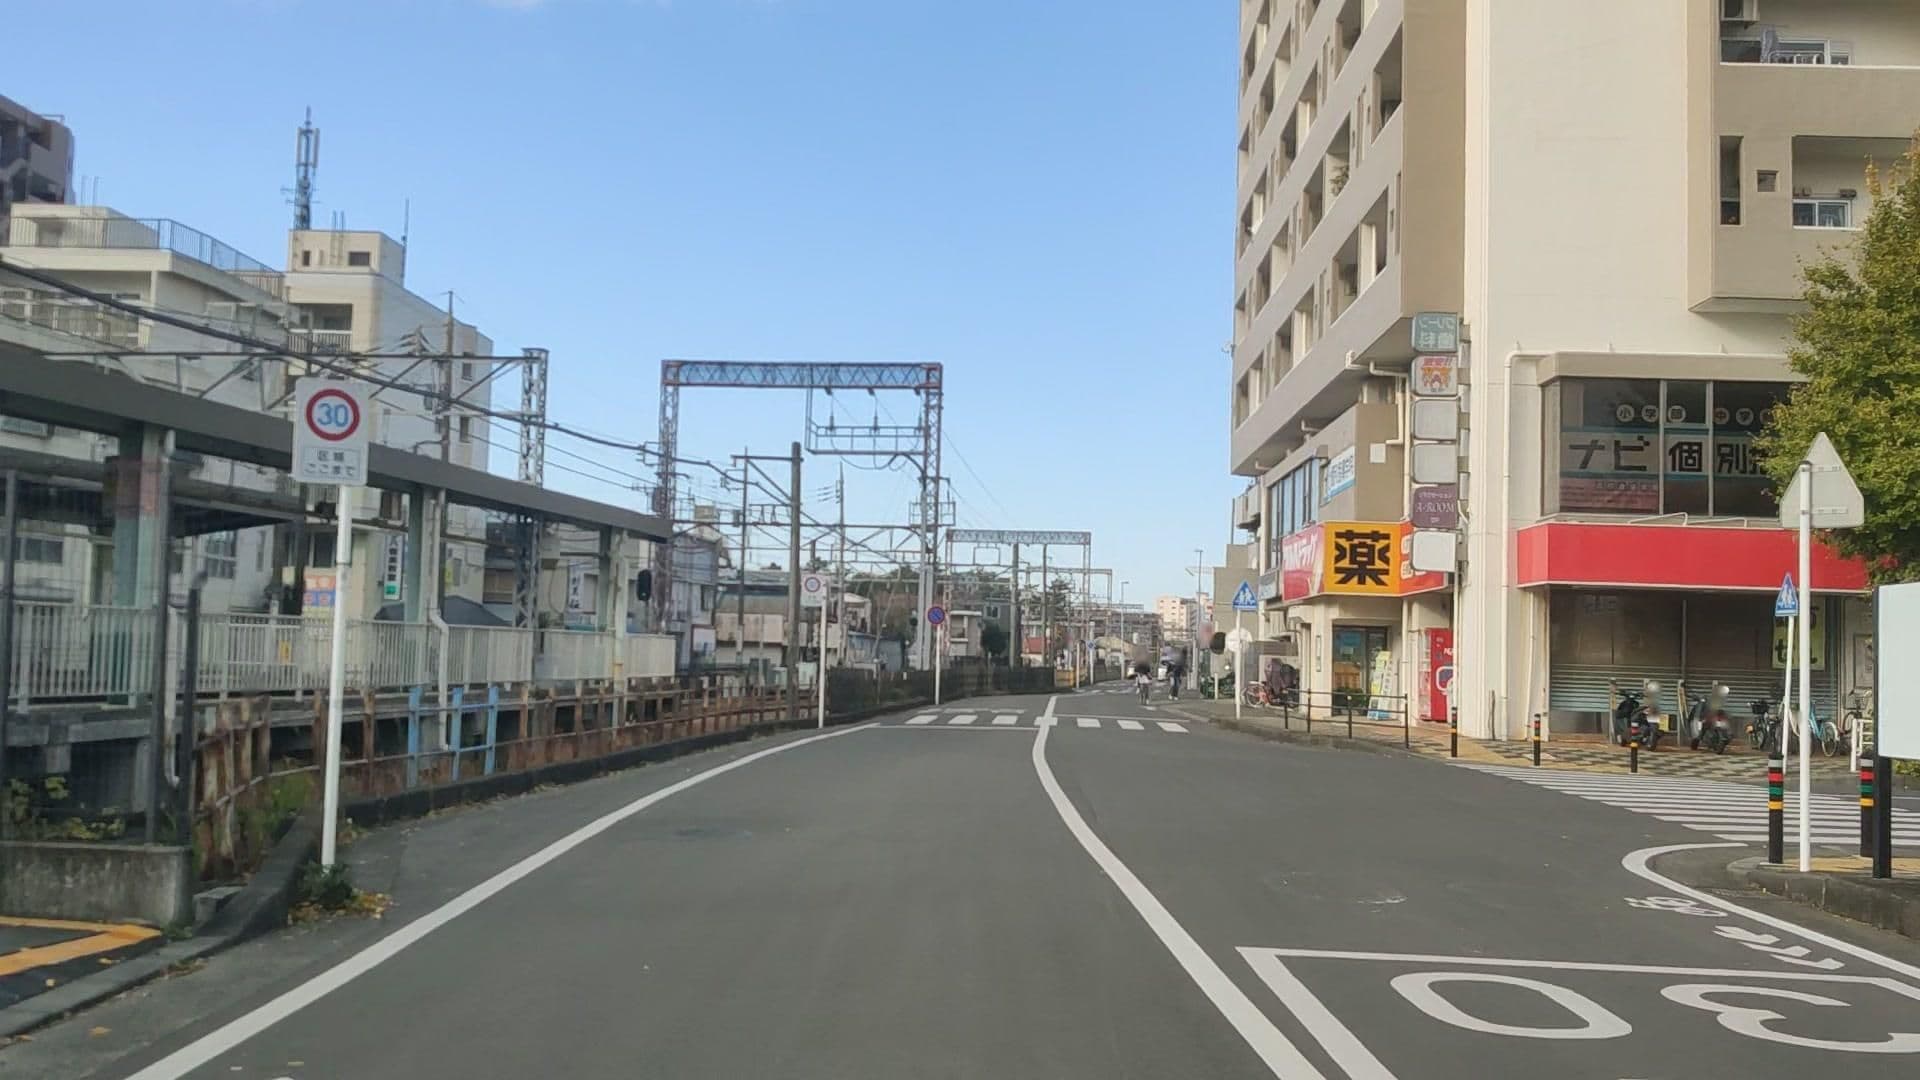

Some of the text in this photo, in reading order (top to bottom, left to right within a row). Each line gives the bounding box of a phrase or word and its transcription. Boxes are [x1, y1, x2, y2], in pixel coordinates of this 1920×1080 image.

[317, 402, 349, 427] 30
[1568, 435, 1766, 475] ナビ個別
[1334, 529, 1391, 587] 薬
